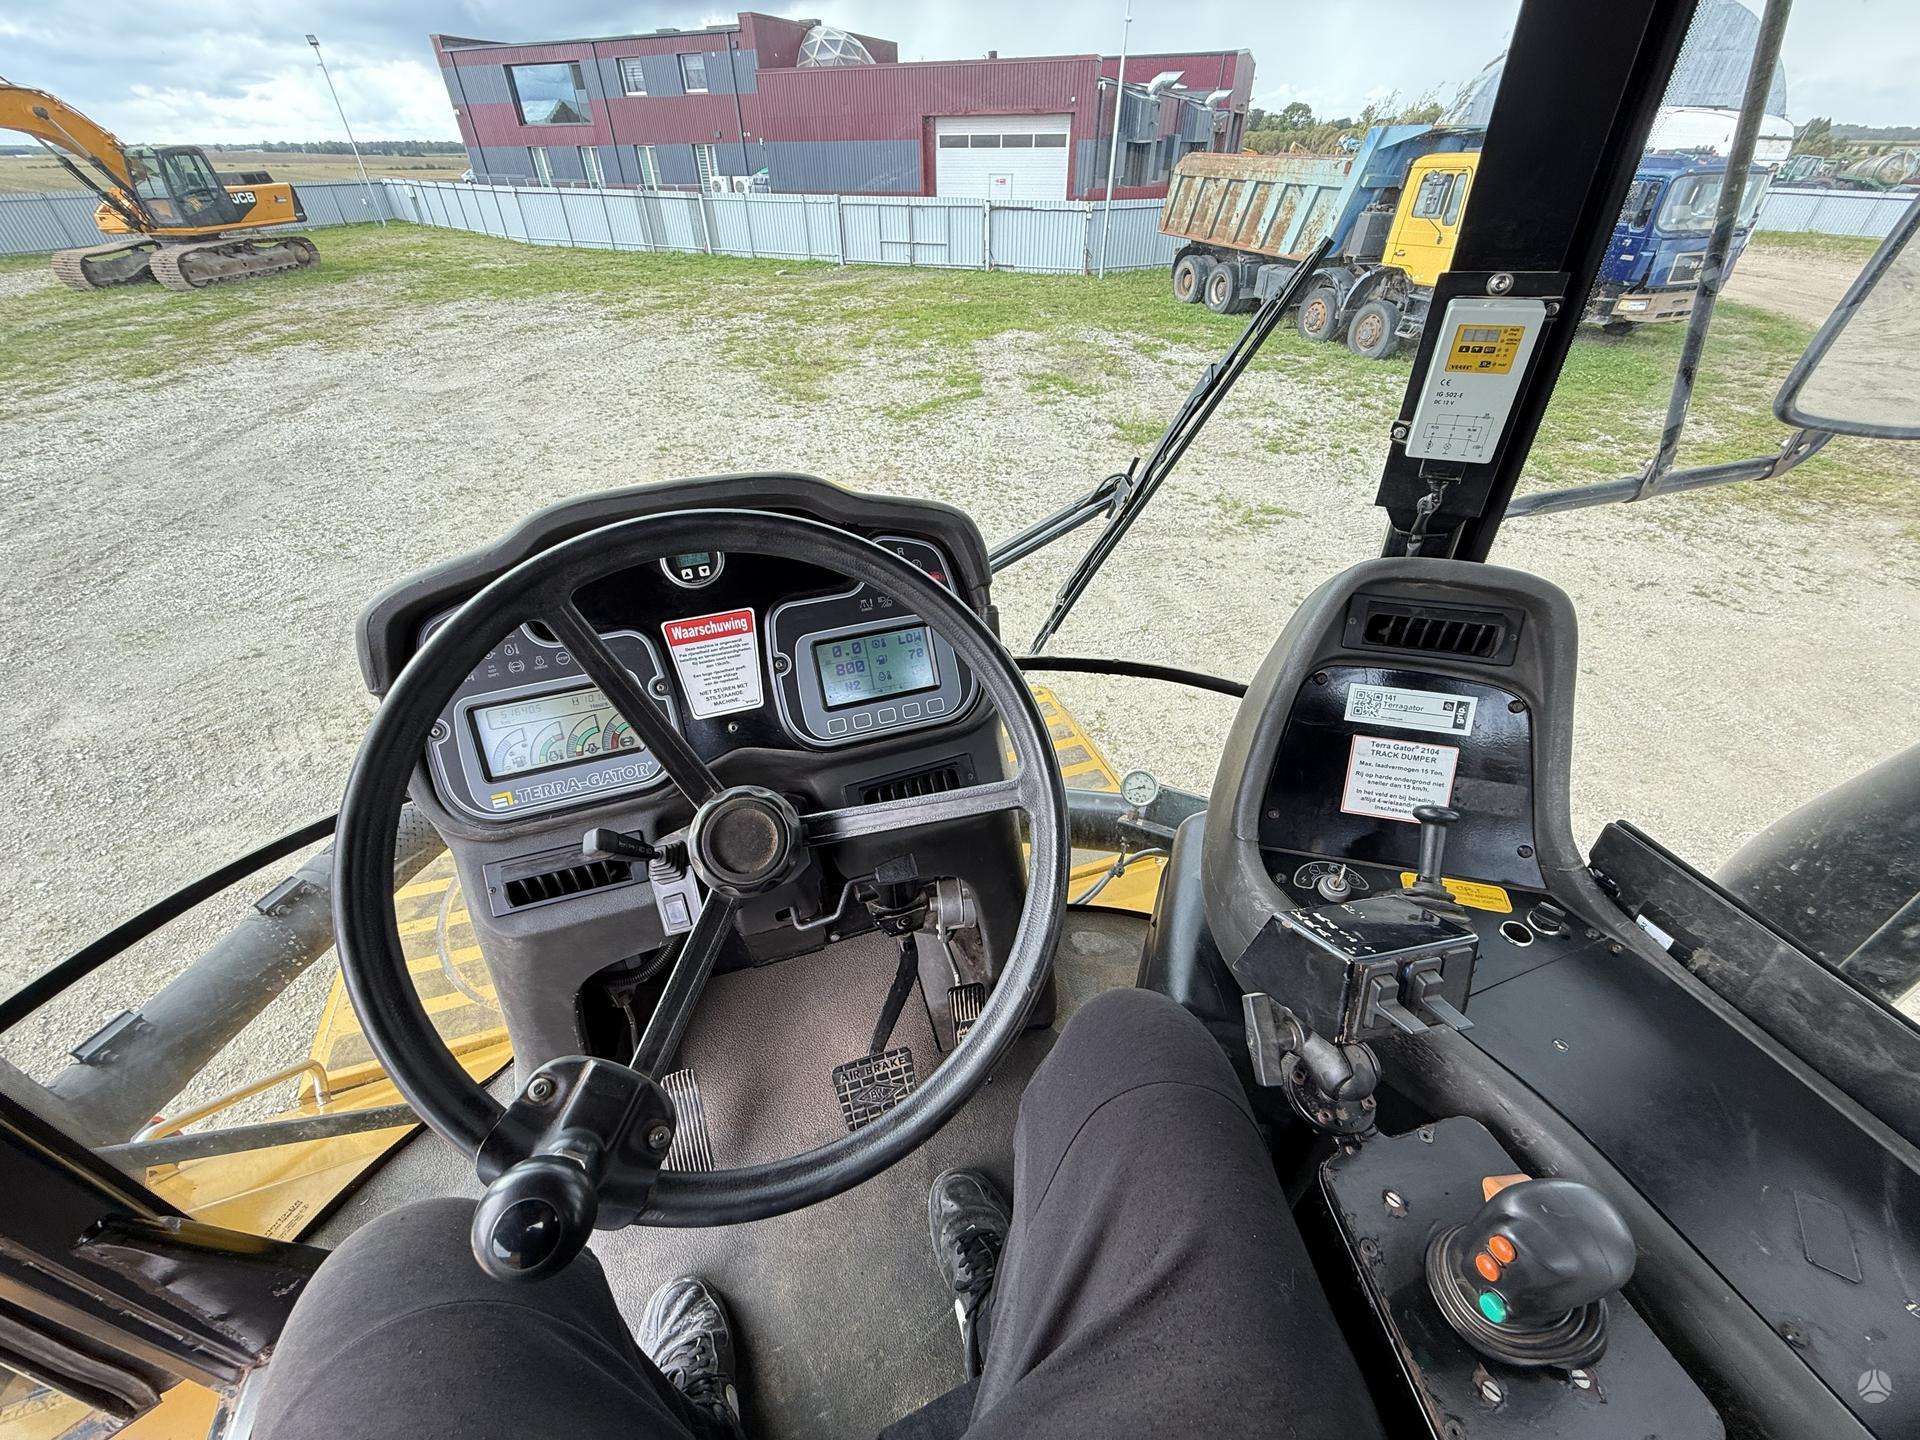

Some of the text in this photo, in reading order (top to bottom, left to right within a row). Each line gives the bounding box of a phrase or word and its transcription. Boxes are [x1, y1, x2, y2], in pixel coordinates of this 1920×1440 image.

[230, 191, 257, 204] JCB
[671, 618, 748, 640] Waarschuwing
[832, 632, 922, 658] 0.0 LOW
[836, 660, 865, 676] 800
[712, 684, 735, 693] STUREN
[706, 690, 743, 702] STILSTAANDE
[1385, 694, 1397, 702] 141
[1383, 701, 1425, 712] Terragator
[1370, 740, 1391, 748] Terra
[1420, 747, 1440, 755] 2104
[1370, 749, 1437, 763] TRACK DUMPER
[1375, 762, 1419, 773] laadvermogen
[517, 762, 649, 802] TERRA-GATOR
[1394, 776, 1431, 787] ondergrond
[840, 1056, 906, 1083] AIR BRAKE
